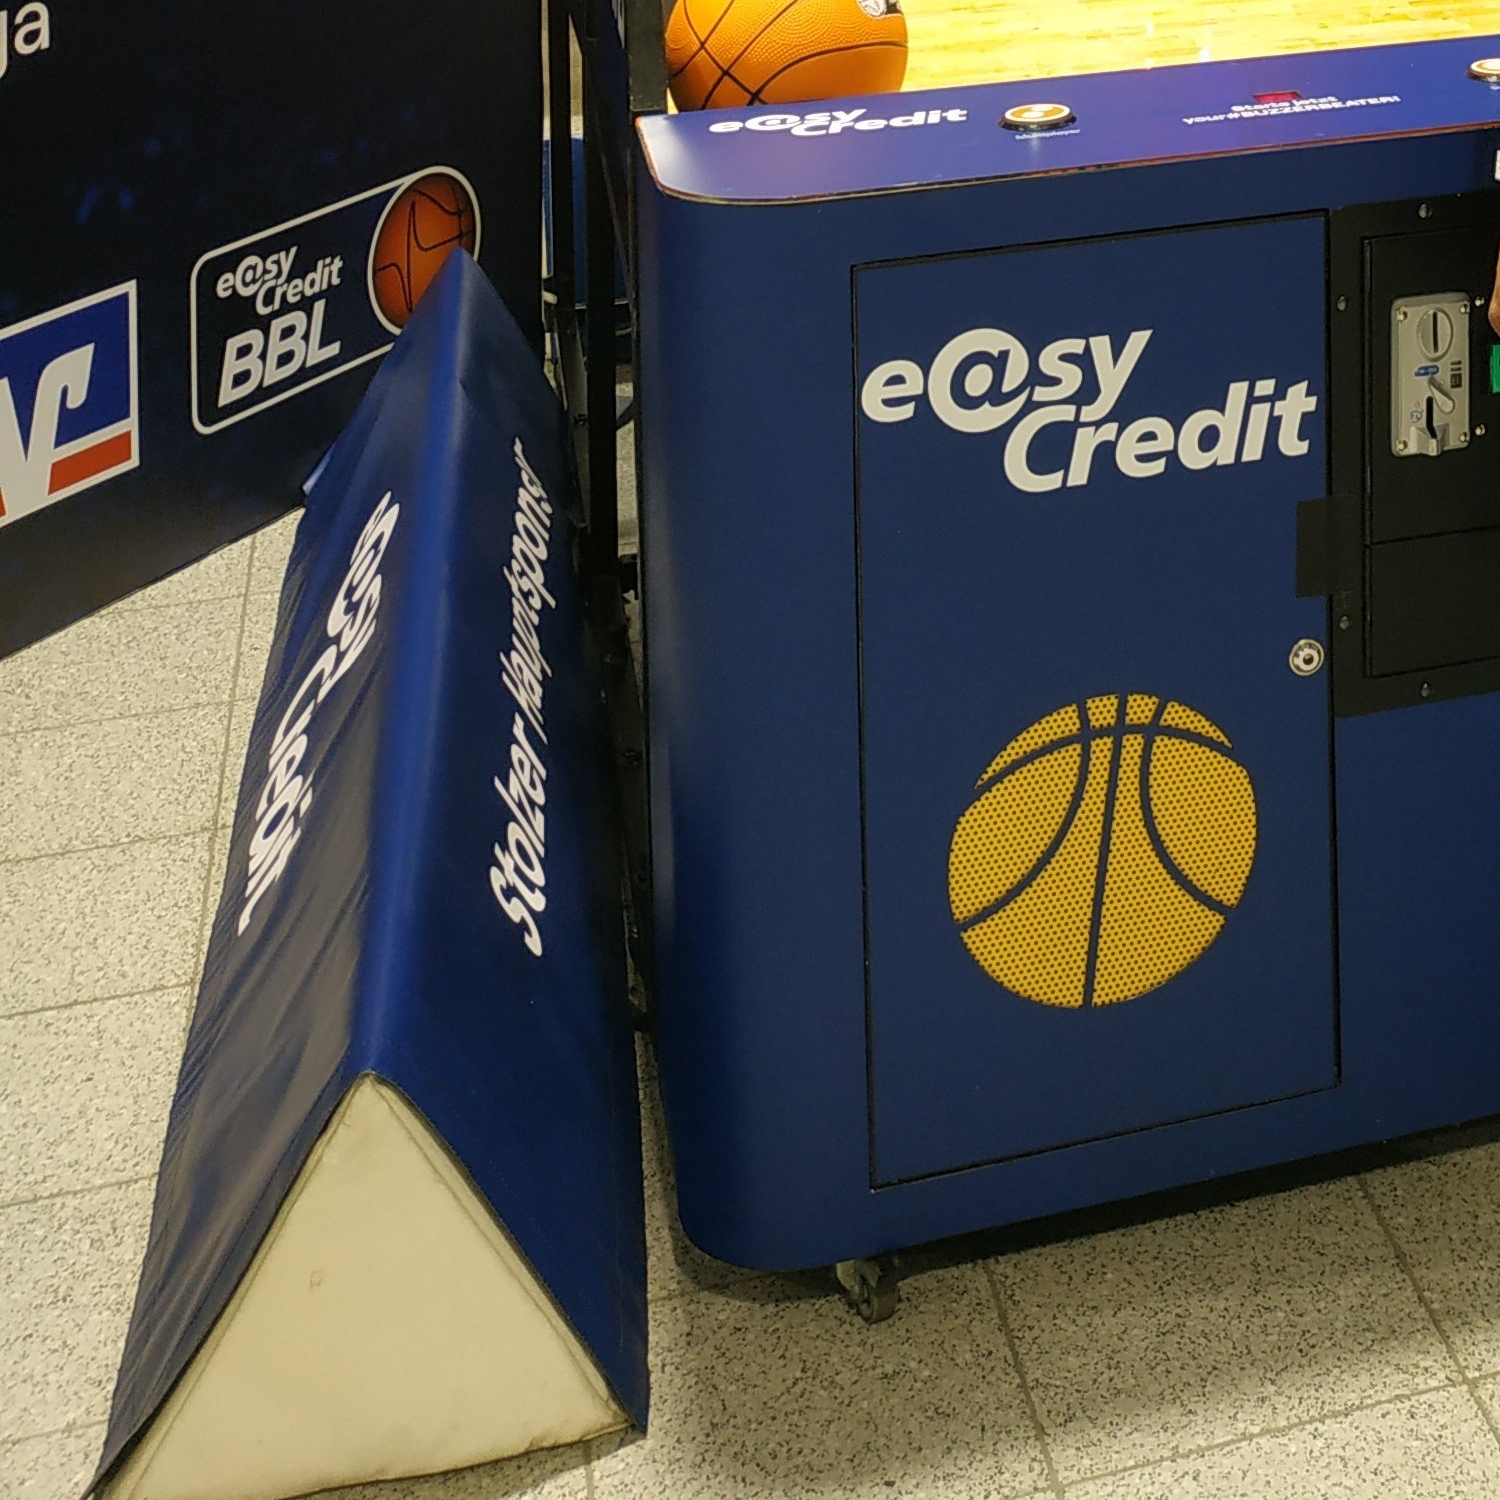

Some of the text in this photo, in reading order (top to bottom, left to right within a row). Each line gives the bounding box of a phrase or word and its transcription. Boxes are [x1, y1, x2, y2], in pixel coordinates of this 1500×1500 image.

[790, 107, 968, 137] Credit
[255, 254, 344, 317] Credit
[217, 298, 342, 408] BBL
[1003, 380, 1318, 493] Credit
[489, 710, 548, 958] Stolzer
